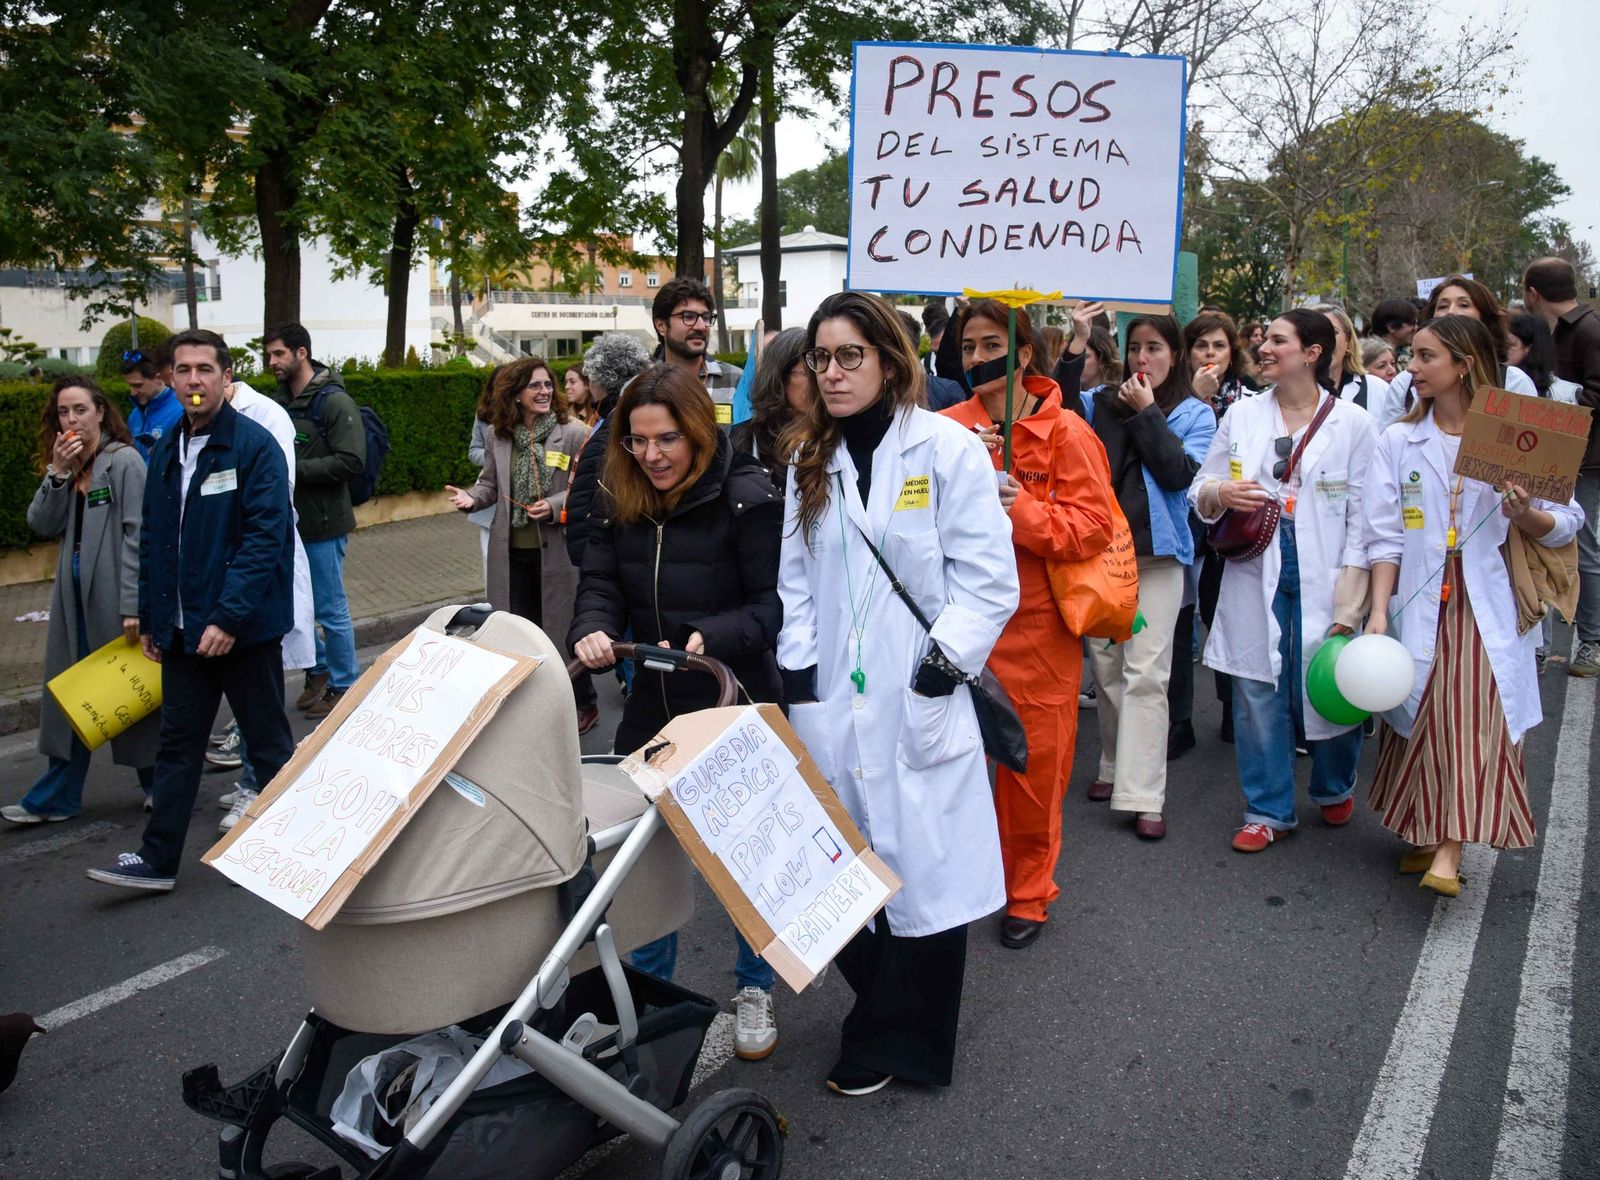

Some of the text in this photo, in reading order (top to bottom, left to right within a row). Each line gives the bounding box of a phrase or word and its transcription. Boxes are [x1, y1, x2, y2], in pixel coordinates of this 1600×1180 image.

[884, 55, 1116, 123] PRESOS
[876, 130, 953, 161] DEL
[860, 174, 1101, 211] TU SALUD
[866, 219, 1144, 263] CONDENADA
[1483, 390, 1510, 418] LA
[1541, 462, 1557, 475] LA
[397, 641, 464, 678] SIN
[337, 709, 438, 768] PADRES
[258, 806, 346, 861] A LA
[224, 838, 328, 903] SEMANA
[756, 846, 813, 917] LOW
[784, 863, 873, 956] BATTERY
